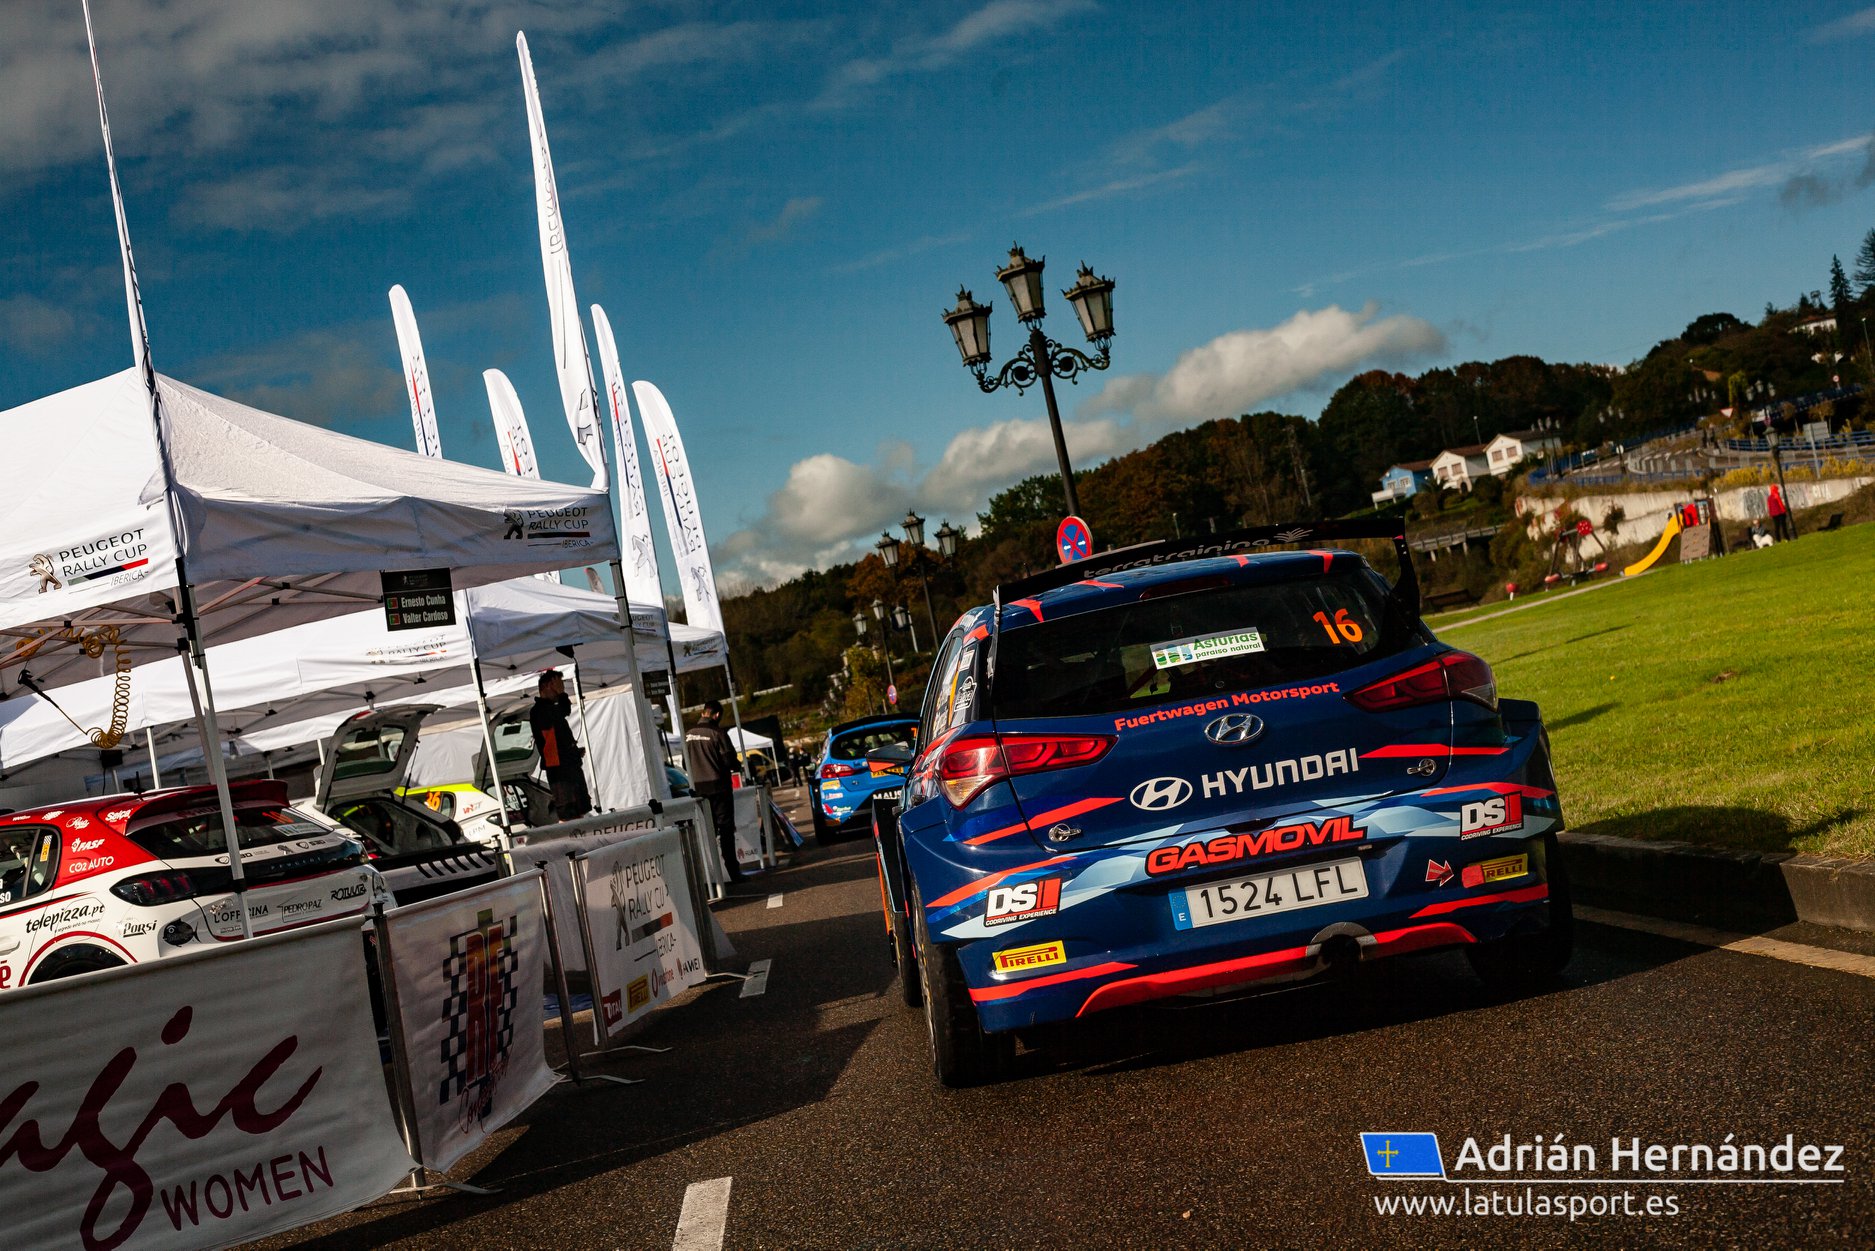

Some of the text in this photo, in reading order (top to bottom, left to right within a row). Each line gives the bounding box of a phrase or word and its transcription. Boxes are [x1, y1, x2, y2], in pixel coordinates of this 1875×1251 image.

[527, 507, 588, 519] PEUGEOT
[529, 519, 589, 531] RALLY CUP
[59, 528, 144, 562] PEUGEOT
[62, 543, 147, 577] RALLY CUP
[110, 569, 145, 587] IBERICA
[401, 594, 446, 608] Ernesto Cunha
[402, 610, 449, 624] Valter Cardoso
[1313, 608, 1362, 645] 16
[1193, 630, 1258, 651] Asturias
[1230, 642, 1261, 653] natural
[1114, 681, 1340, 731] Fuertwagen Motorsport
[1201, 747, 1359, 799] HYUNDAI
[873, 790, 902, 800] MAUS
[593, 818, 656, 837] PEUGEO
[1492, 823, 1522, 834] EXPERIENCE
[1147, 817, 1364, 874] GASMOVIL
[69, 856, 114, 873] CO2 AUTO
[626, 854, 665, 888] PEUGEOT
[1200, 866, 1358, 918] 1524 LFL
[26, 905, 105, 934] telepizza.pt
[214, 905, 269, 924] L'OFFINA
[985, 909, 1057, 926] CODRIVING EXPERIENCE
[1178, 912, 1187, 921] E
[1000, 946, 1059, 968] PIRELLI
[0, 1006, 322, 1251] agic
[160, 1146, 334, 1231] WOMEN
